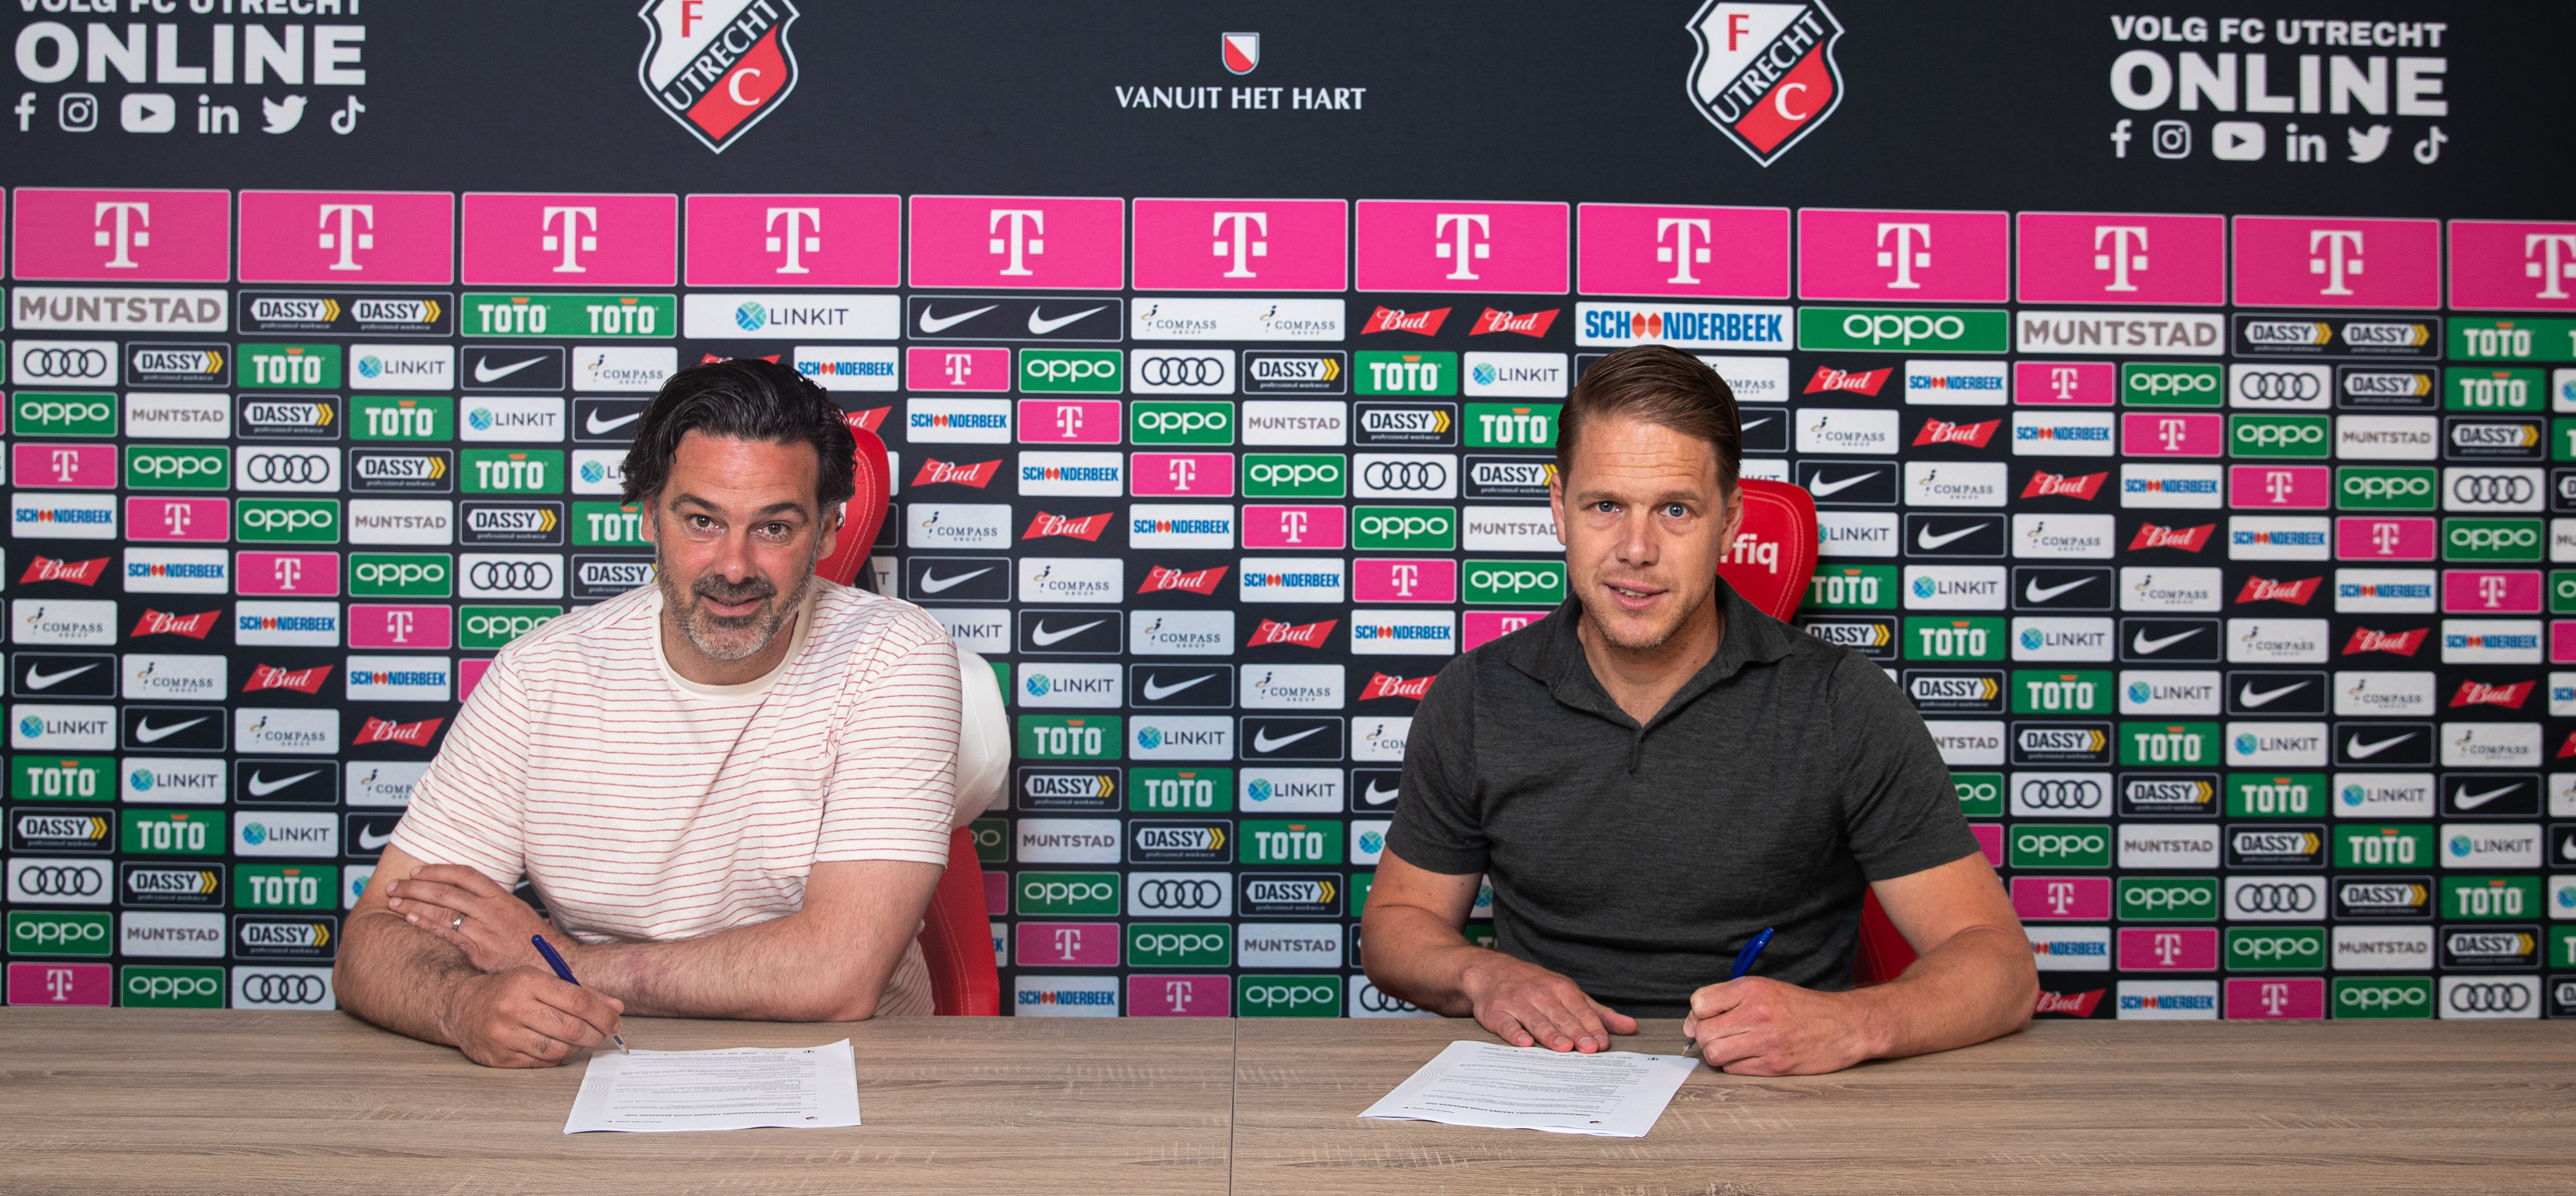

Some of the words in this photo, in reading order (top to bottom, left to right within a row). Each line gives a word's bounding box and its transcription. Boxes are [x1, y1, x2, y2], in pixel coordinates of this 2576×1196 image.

[681, 0, 704, 38] F
[1728, 13, 1749, 52] F
[2112, 16, 2207, 42] VOLG
[2221, 18, 2264, 43] FC
[2277, 19, 2446, 47] UTRECHT
[16, 22, 365, 85] ONLINE
[662, 0, 779, 111] UTRECHT
[1710, 9, 1825, 124] UTRECHT
[728, 67, 761, 106] C
[2111, 50, 2447, 116] ONLINE
[1115, 86, 1222, 108] VANUIT
[1232, 87, 1283, 108] HET
[1293, 88, 1366, 109] HART
[1774, 82, 1807, 121] C
[19, 296, 220, 323] MUNTSTAD
[360, 303, 419, 319] DASSY
[478, 304, 546, 333] TOTO
[770, 309, 848, 325] LINKIT
[1275, 321, 1335, 330] COMPASS
[1381, 310, 1430, 330] Bud
[1843, 314, 1965, 345] oppo
[2025, 320, 2217, 347] MUNTSTAD
[2254, 325, 2311, 341] DASSY
[2464, 329, 2531, 357] TOTO
[142, 354, 201, 369] DASSY
[253, 355, 320, 384] TOTO
[1027, 359, 1115, 382] oppo
[1259, 362, 1318, 377] DASSY
[603, 370, 663, 379] COMPASS
[1369, 363, 1438, 391] TOTO
[1499, 368, 1559, 382] LINKIT
[1823, 370, 1871, 389] Bud
[2130, 373, 2216, 396] oppo
[20, 402, 110, 426] oppo
[132, 409, 224, 422] MUNTSTAD
[253, 406, 312, 422] DASSY
[365, 407, 433, 436] TOTO
[496, 413, 556, 426] LINKIT
[1138, 412, 1227, 434] oppo
[1249, 417, 1340, 429] MUNTSTAD
[1370, 413, 1429, 429] DASSY
[1480, 414, 1547, 443] TOTO
[1826, 432, 1885, 442] COMPASS
[2343, 432, 2431, 444] MUNTSTAD
[476, 461, 543, 489] TOTO
[931, 462, 980, 482] Bud
[1250, 464, 1338, 487] oppo
[1480, 466, 1539, 482] DASSY
[2039, 474, 2087, 494] Bud
[244, 509, 332, 532] oppo
[355, 516, 446, 528] MUNTSTAD
[476, 512, 535, 528] DASSY
[1042, 515, 1091, 535] Bud
[1360, 517, 1448, 539] oppo
[937, 527, 997, 536] COMPASS
[1830, 527, 1889, 541] LINKIT
[2042, 537, 2100, 546] COMPASS
[2451, 528, 2537, 550] oppo
[39, 559, 89, 579] Bud
[356, 564, 444, 586] oppo
[588, 566, 647, 582] DASSY
[1158, 569, 1207, 589] Bud
[1049, 581, 1109, 591] COMPASS
[1471, 571, 1559, 593] oppo
[42, 622, 103, 634] COMPASS
[150, 612, 200, 632] Bud
[1267, 622, 1316, 642] Bud
[1160, 634, 1220, 643] COMPASS
[1920, 628, 1986, 656] TOTO
[2046, 632, 2105, 646] LINKIT
[2360, 630, 2409, 650] Bud
[263, 668, 312, 687] Bud
[1054, 679, 1114, 692] LINKIT
[1920, 681, 1977, 696] DASSY
[47, 721, 107, 734] LINKIT
[265, 732, 325, 741] COMPASS
[373, 720, 422, 740] Bud
[1034, 727, 1101, 755] TOTO
[1164, 732, 1225, 745] LINKIT
[2135, 733, 2201, 761] TOTO
[2260, 737, 2318, 751] LINKIT
[27, 768, 95, 796] TOTO
[157, 774, 217, 788] LINKIT
[1034, 778, 1093, 794] DASSY
[1274, 784, 1335, 797] LINKIT
[2135, 784, 2192, 800] DASSY
[269, 828, 330, 841] LINKIT
[1255, 831, 1322, 859] TOTO
[2018, 835, 2104, 857] oppo
[2125, 840, 2213, 852] MUNTSTAD
[137, 873, 196, 890] DASSY
[249, 876, 317, 905] TOTO
[1024, 882, 1113, 905] oppo
[1255, 884, 1314, 900] DASSY
[2349, 887, 2406, 903] DASSY
[2456, 887, 2522, 915] TOTO
[16, 922, 104, 945] oppo
[127, 927, 219, 941] MUNTSTAD
[1244, 940, 1336, 952] MUNTSTAD
[2339, 941, 2427, 954] MUNTSTAD
[1245, 986, 1333, 1008] oppo
[2340, 987, 2426, 1009] oppo
